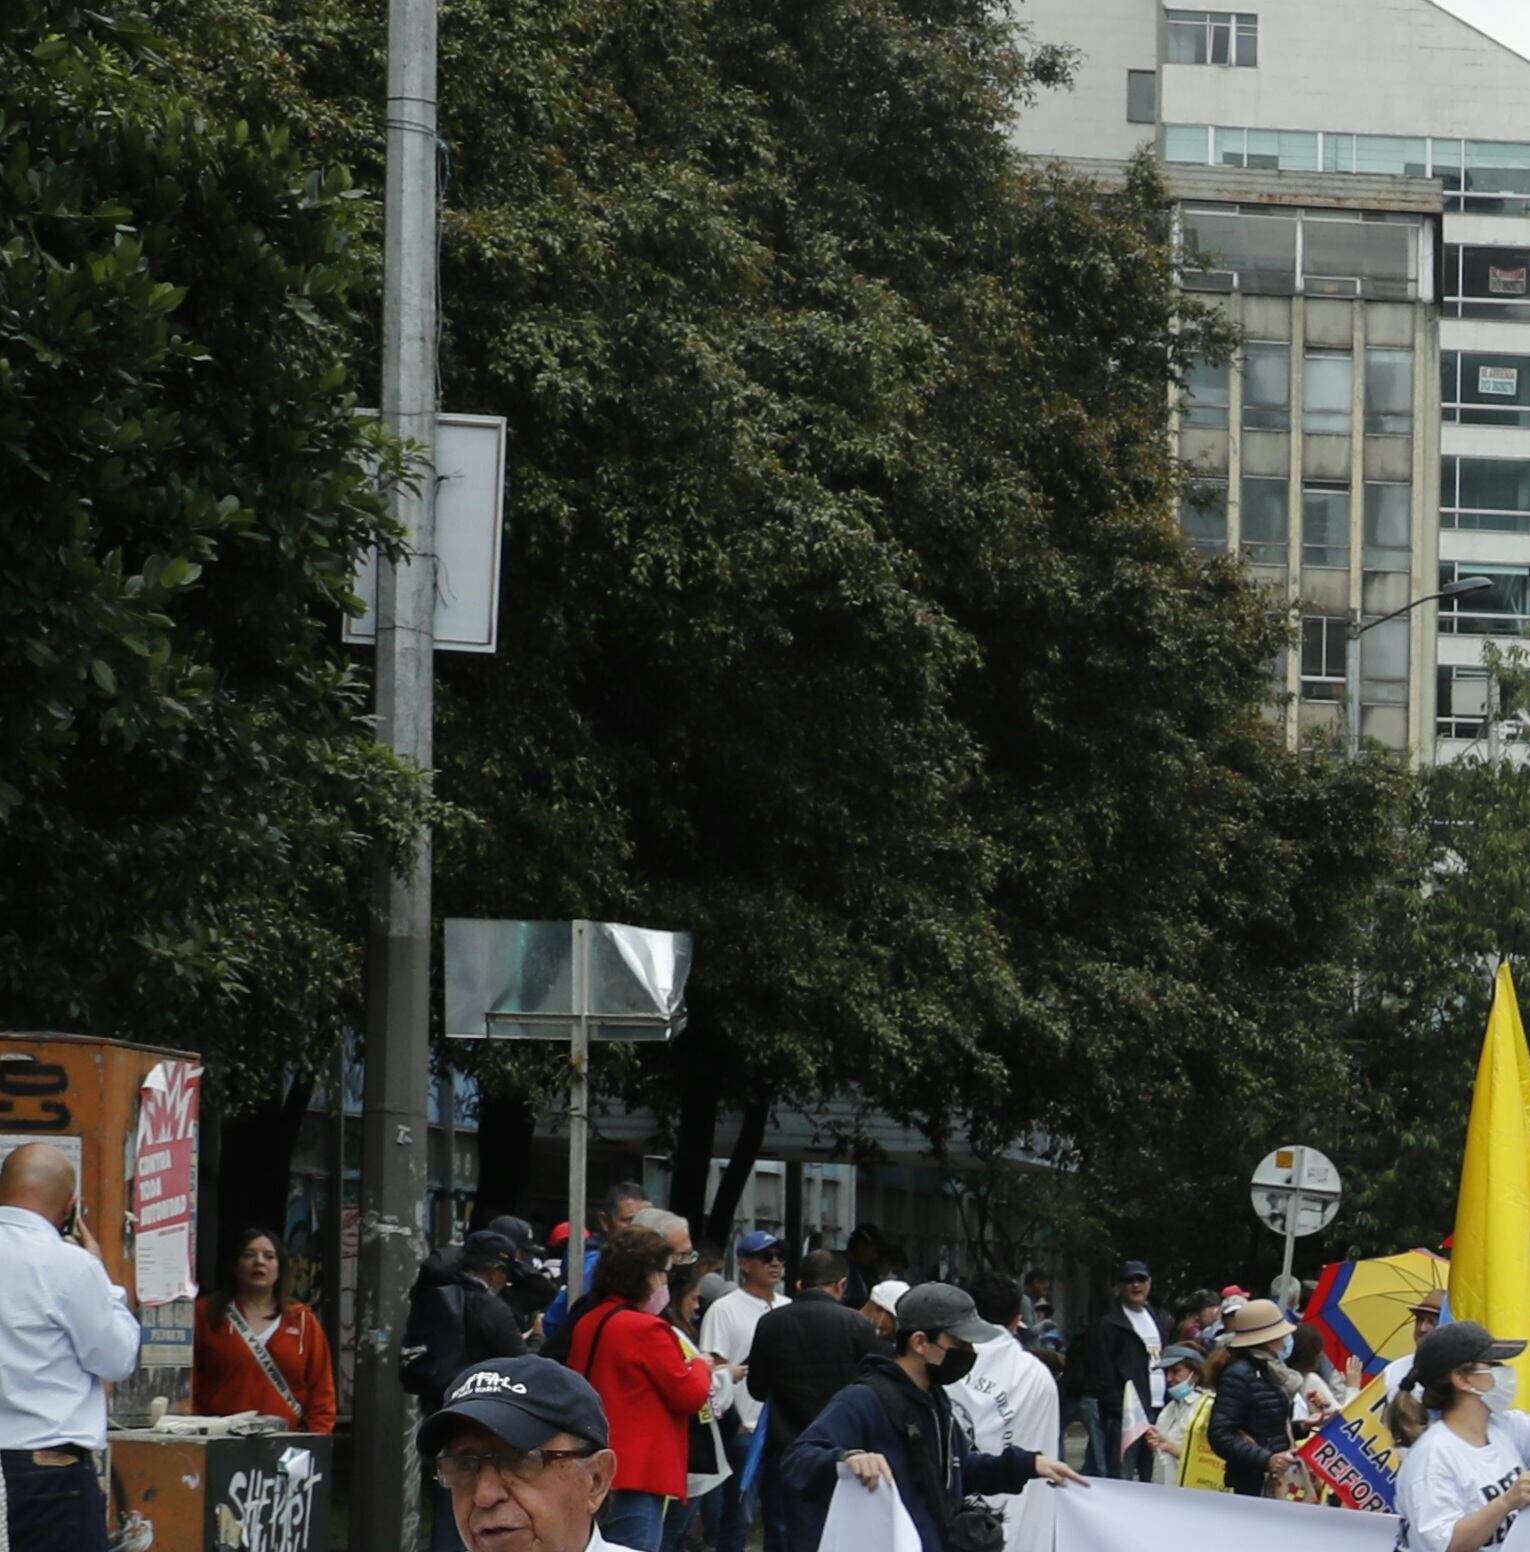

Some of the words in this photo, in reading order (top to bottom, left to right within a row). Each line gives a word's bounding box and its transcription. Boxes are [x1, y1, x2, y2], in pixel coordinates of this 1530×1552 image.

[1343, 1418, 1364, 1441] A
[1360, 1435, 1392, 1470] LA
[1313, 1442, 1393, 1513] REFOR
